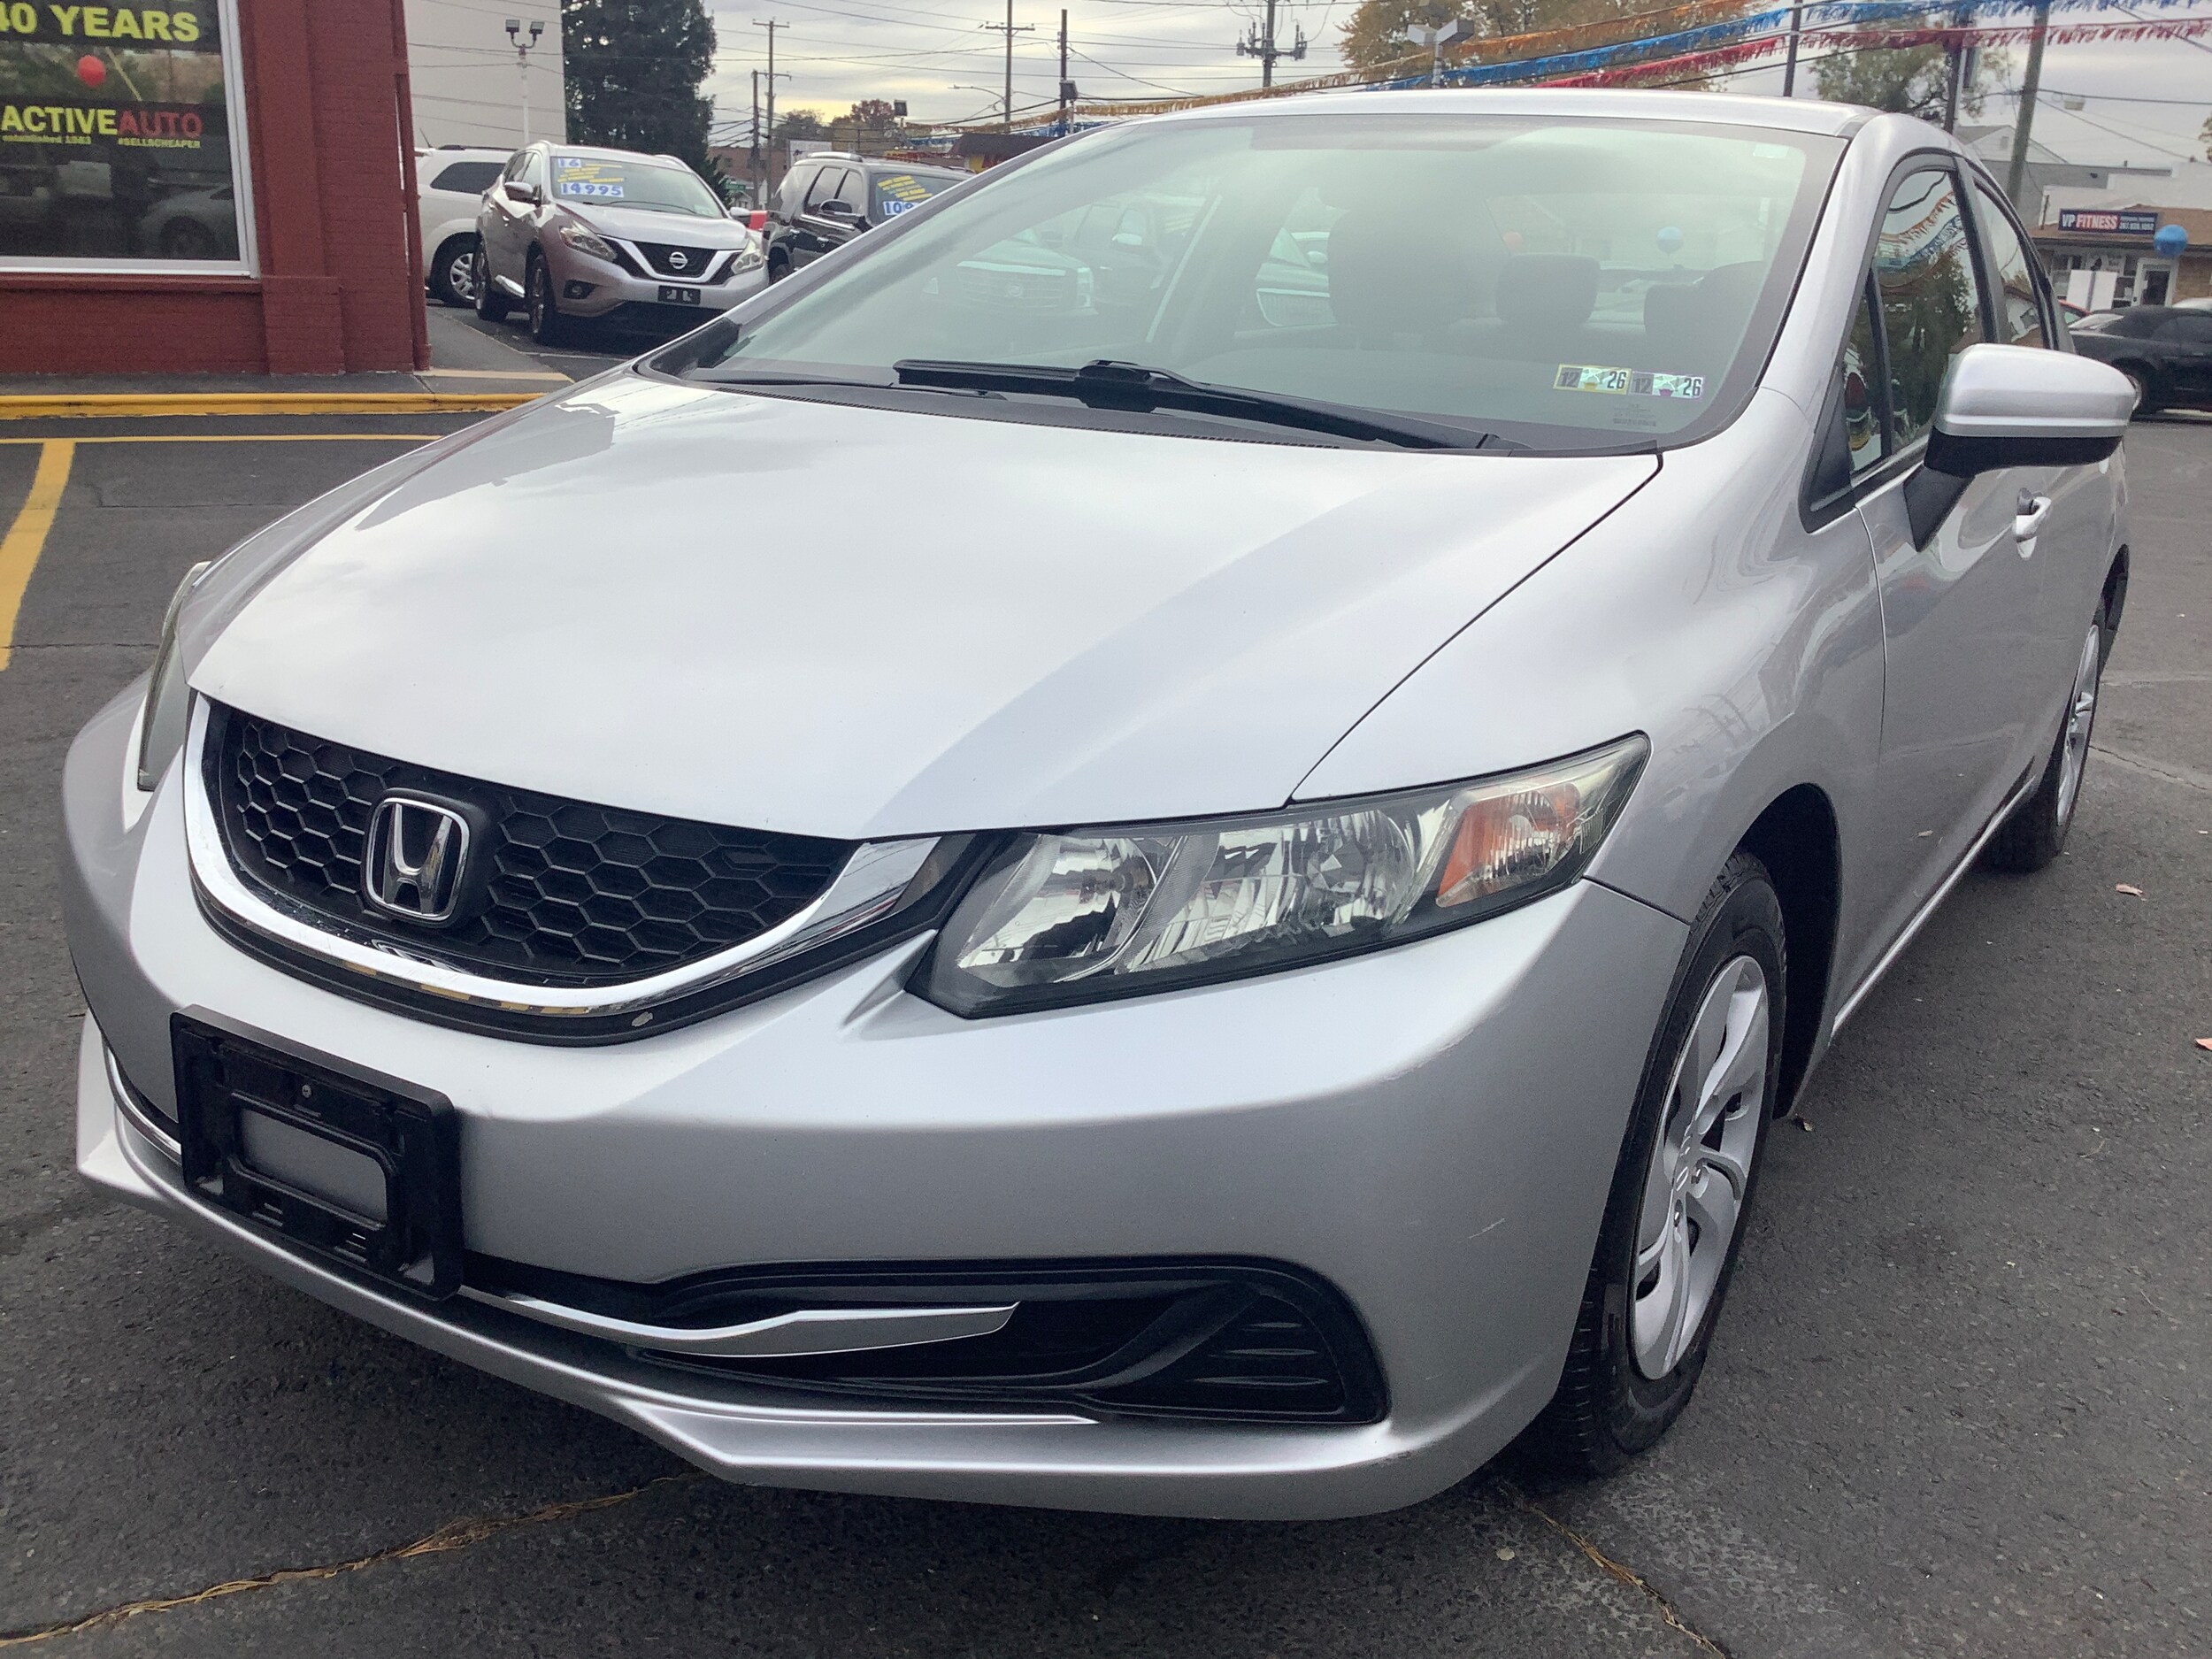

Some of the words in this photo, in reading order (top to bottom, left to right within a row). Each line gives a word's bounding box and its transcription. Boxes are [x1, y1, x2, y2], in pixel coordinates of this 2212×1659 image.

[50, 4, 200, 42] YEARS
[559, 158, 580, 167] 16
[562, 183, 622, 196] 14995
[2062, 213, 2076, 227] VP
[2076, 213, 2118, 229] FITNESS
[1560, 371, 1579, 388] 12
[1607, 371, 1627, 389] 26
[1632, 377, 1652, 395] 12
[1683, 378, 1701, 397] 26
